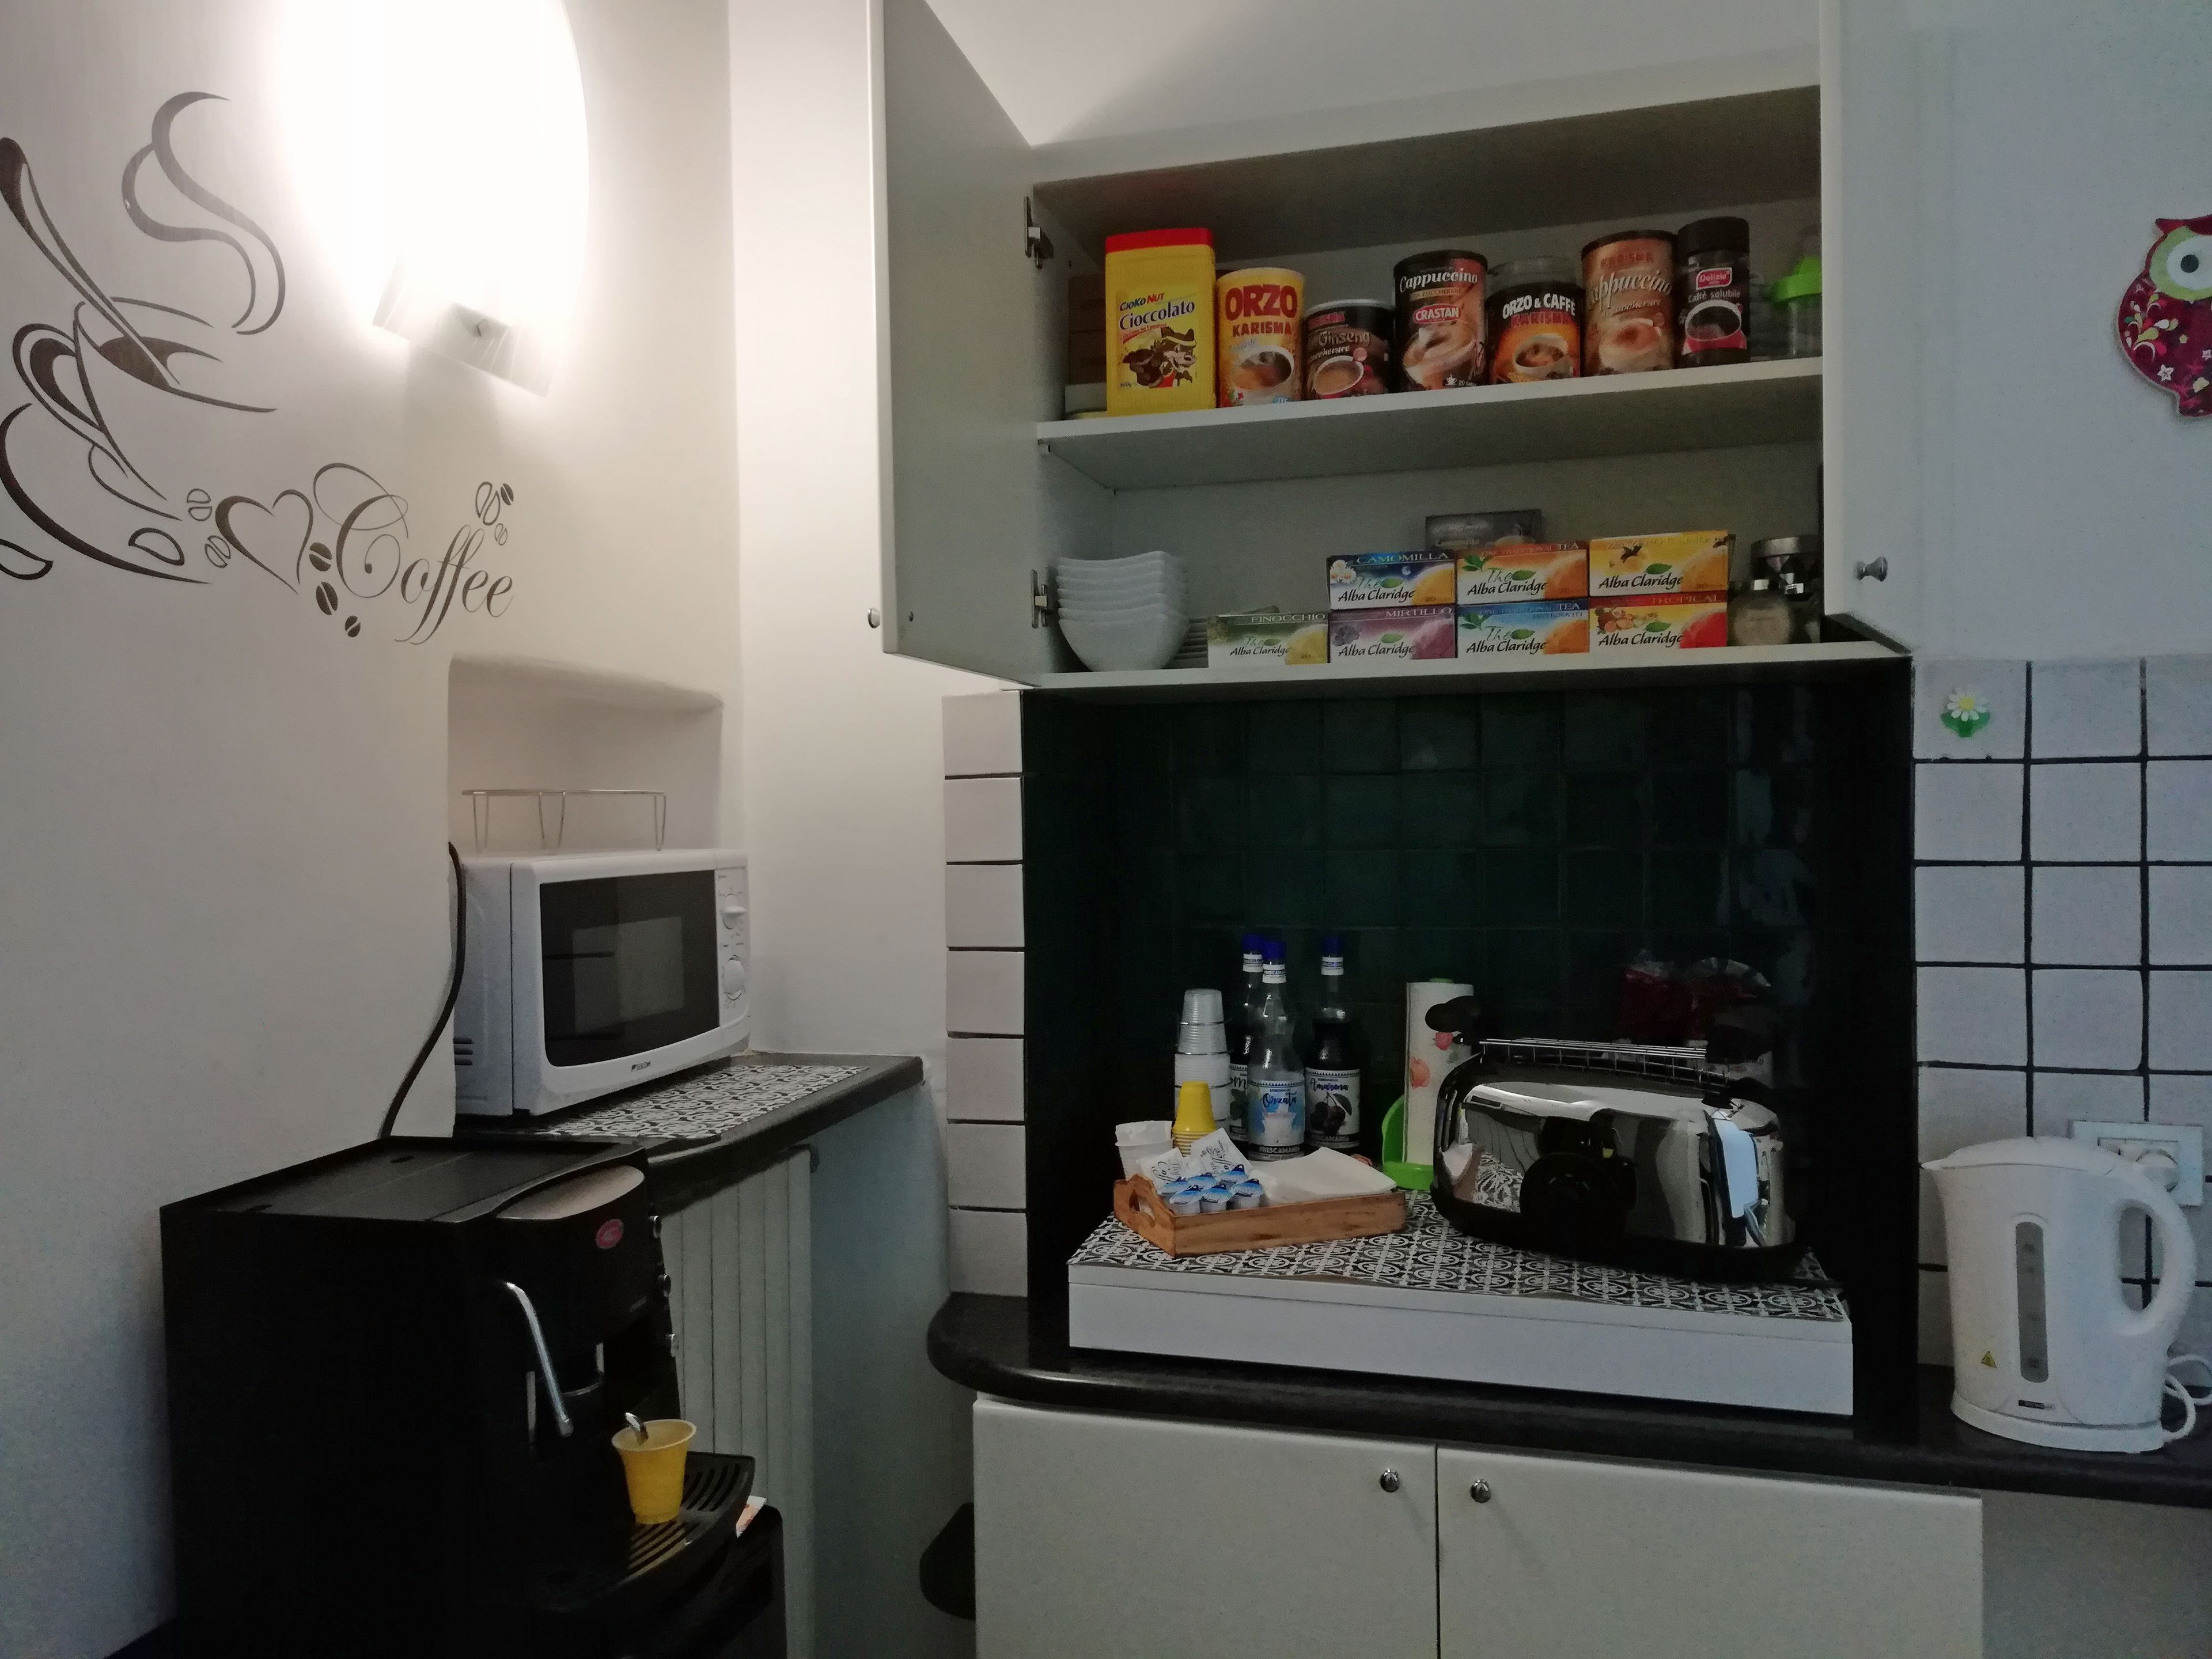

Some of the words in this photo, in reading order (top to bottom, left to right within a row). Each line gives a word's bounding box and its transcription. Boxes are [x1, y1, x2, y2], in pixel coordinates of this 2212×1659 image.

[1400, 268, 1479, 293] Cappuccino
[1590, 269, 1672, 312] appuccino
[1688, 290, 1707, 303] Caffè
[1710, 289, 1741, 300] solubile
[1225, 284, 1298, 321] ORZO
[1502, 294, 1533, 319] ORZO
[1534, 298, 1541, 308] &
[1119, 301, 1195, 330] Cioccolato
[1415, 307, 1460, 321] CRASTAN
[1233, 321, 1292, 337] KARISMA
[1319, 331, 1371, 346] Ginseng
[313, 463, 514, 645] Coffee
[1357, 552, 1450, 564] CAMOMILLA
[1467, 582, 1496, 596] Alba
[1498, 579, 1548, 596] Claridge
[1599, 574, 1630, 589] Alba
[1631, 573, 1684, 590] Claridge
[1338, 589, 1366, 602] Alba
[1368, 587, 1415, 603] Claridge
[1652, 594, 1721, 604] TROPICAL
[1386, 607, 1452, 618] MIRTILLO
[1558, 603, 1580, 611] TEA
[1251, 613, 1325, 623] FINOCCHIO
[1466, 640, 1495, 653] Alba
[1497, 638, 1549, 655] Claridge
[1599, 633, 1629, 646] Alba
[1631, 631, 1683, 648] Claridge
[1230, 646, 1251, 656] Alba
[1253, 645, 1292, 657] Claridge
[1338, 644, 1365, 657] Alba
[1368, 642, 1415, 658] Claridge
[1309, 1078, 1349, 1092] Amarena
[1263, 1092, 1297, 1108] Orzata
